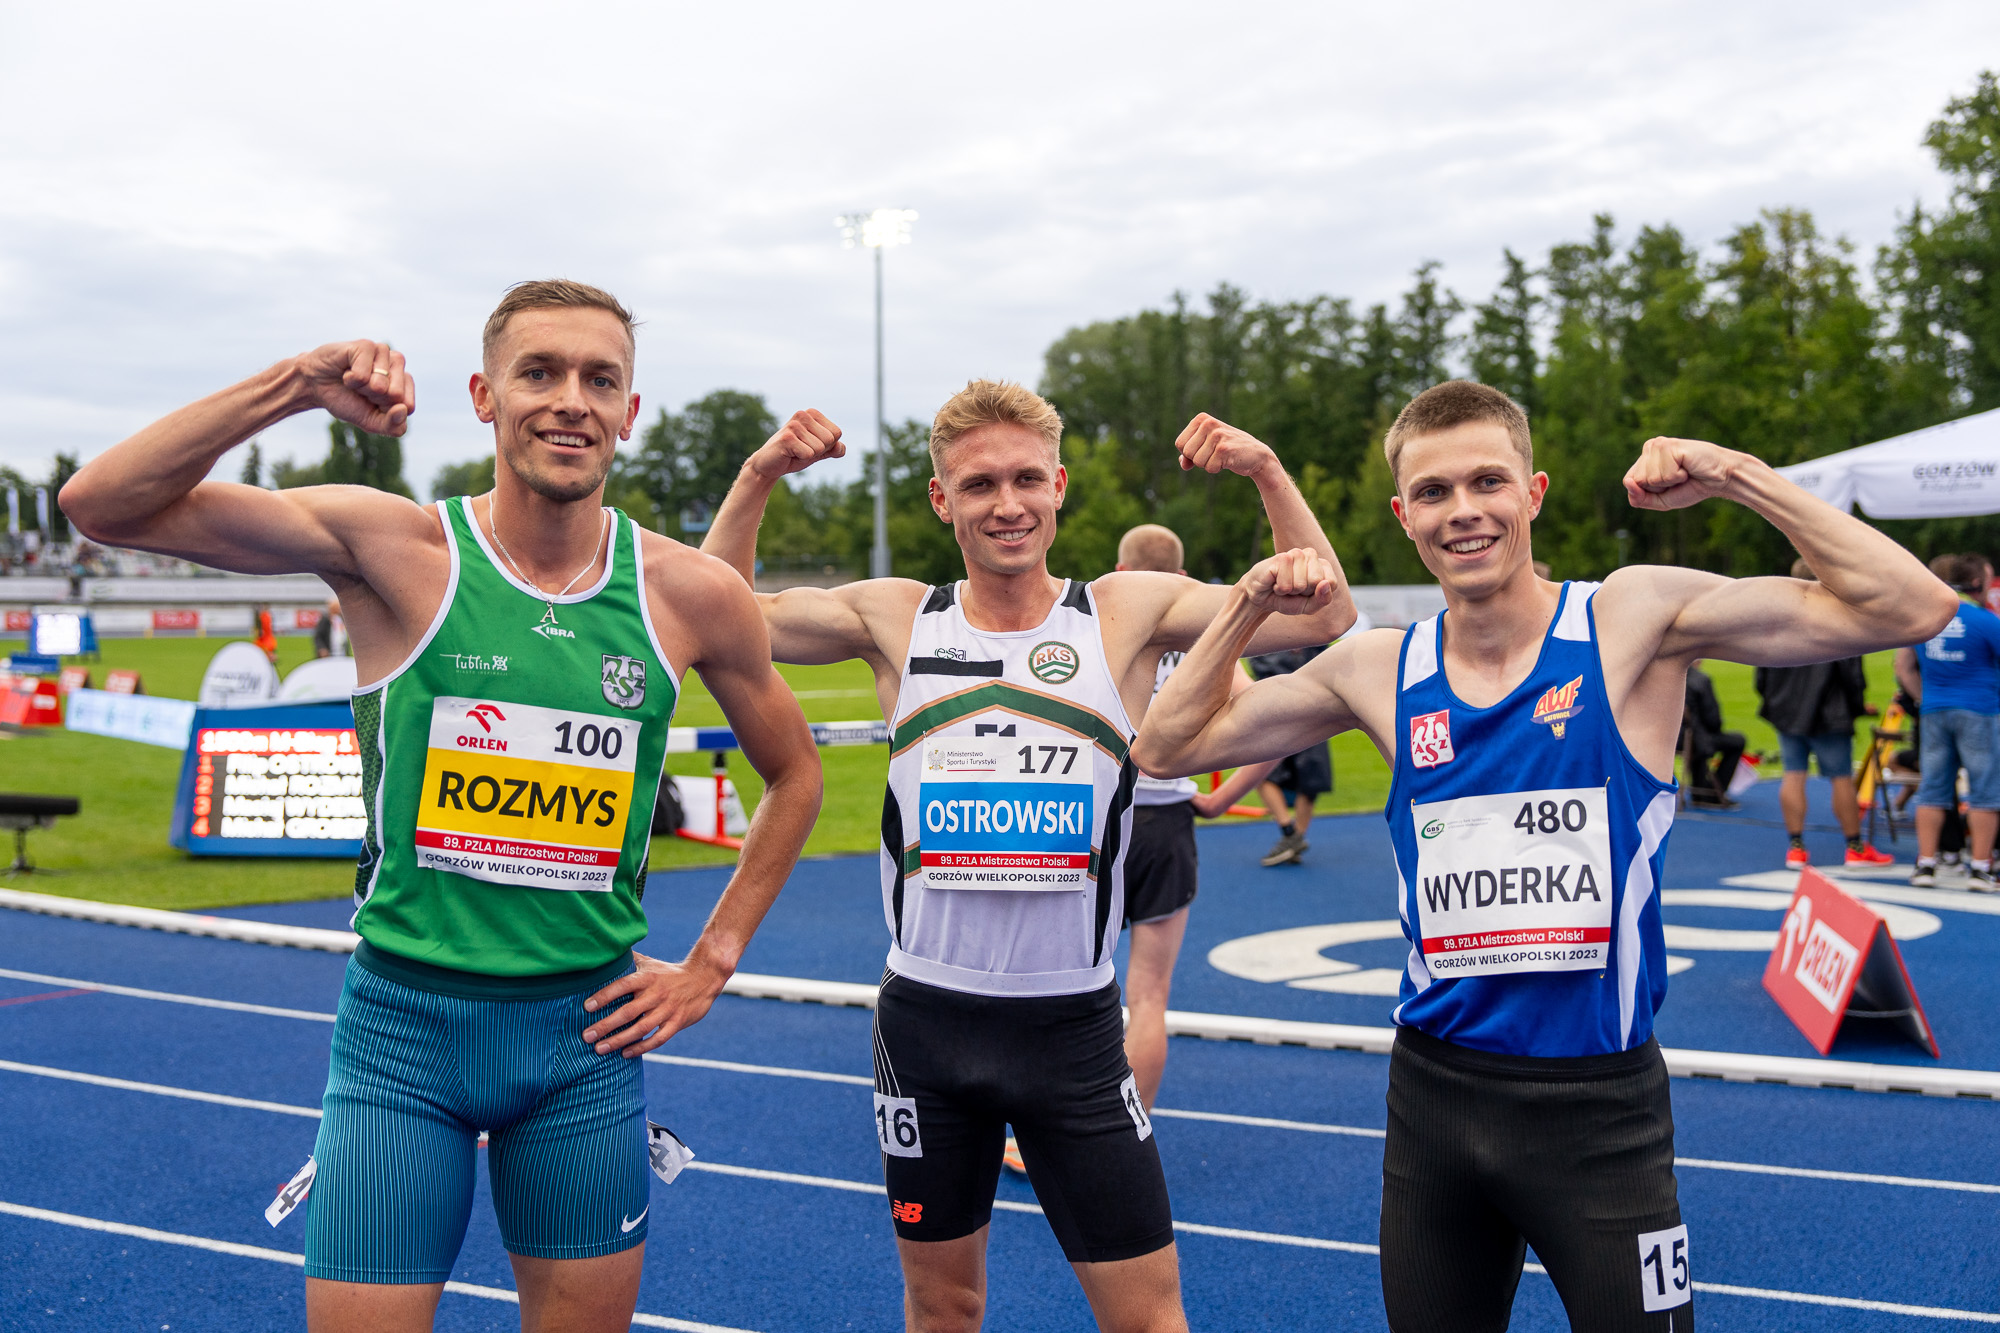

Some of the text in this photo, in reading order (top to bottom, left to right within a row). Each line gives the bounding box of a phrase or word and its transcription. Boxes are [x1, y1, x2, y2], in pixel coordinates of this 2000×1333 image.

[1036, 647, 1071, 666] RKS
[1533, 675, 1583, 718] AWF
[1543, 710, 1571, 723] KATOWICE
[456, 735, 508, 752] ORLEN
[554, 720, 623, 760] 100
[946, 758, 966, 766] Sportu
[970, 758, 997, 766] Turystyki
[1018, 745, 1079, 775] 177
[437, 770, 618, 828] ROZMYS
[925, 799, 1084, 835] OSTROWSKI
[1513, 799, 1587, 835] 480
[443, 836, 599, 864] 99. PZLA Mistrzostwa Polski
[940, 855, 1070, 867] 99. PZLA Mistrzostwa Polski
[425, 853, 608, 882] GORZÓW WIELKOPOLSKI 2023
[928, 870, 1080, 883] GORZÓW WIELKOPOLSKI 2023
[1423, 864, 1602, 913] WYDERKA
[1443, 929, 1585, 950] 99. PZLA Mistrzostwa Polski
[1434, 949, 1599, 969] GORZÓW WIELKOPOLSKI 2023
[1802, 931, 1851, 998] ORLEN
[877, 1104, 918, 1148] 16
[278, 1173, 313, 1215] 4
[1644, 1237, 1688, 1296] 15
